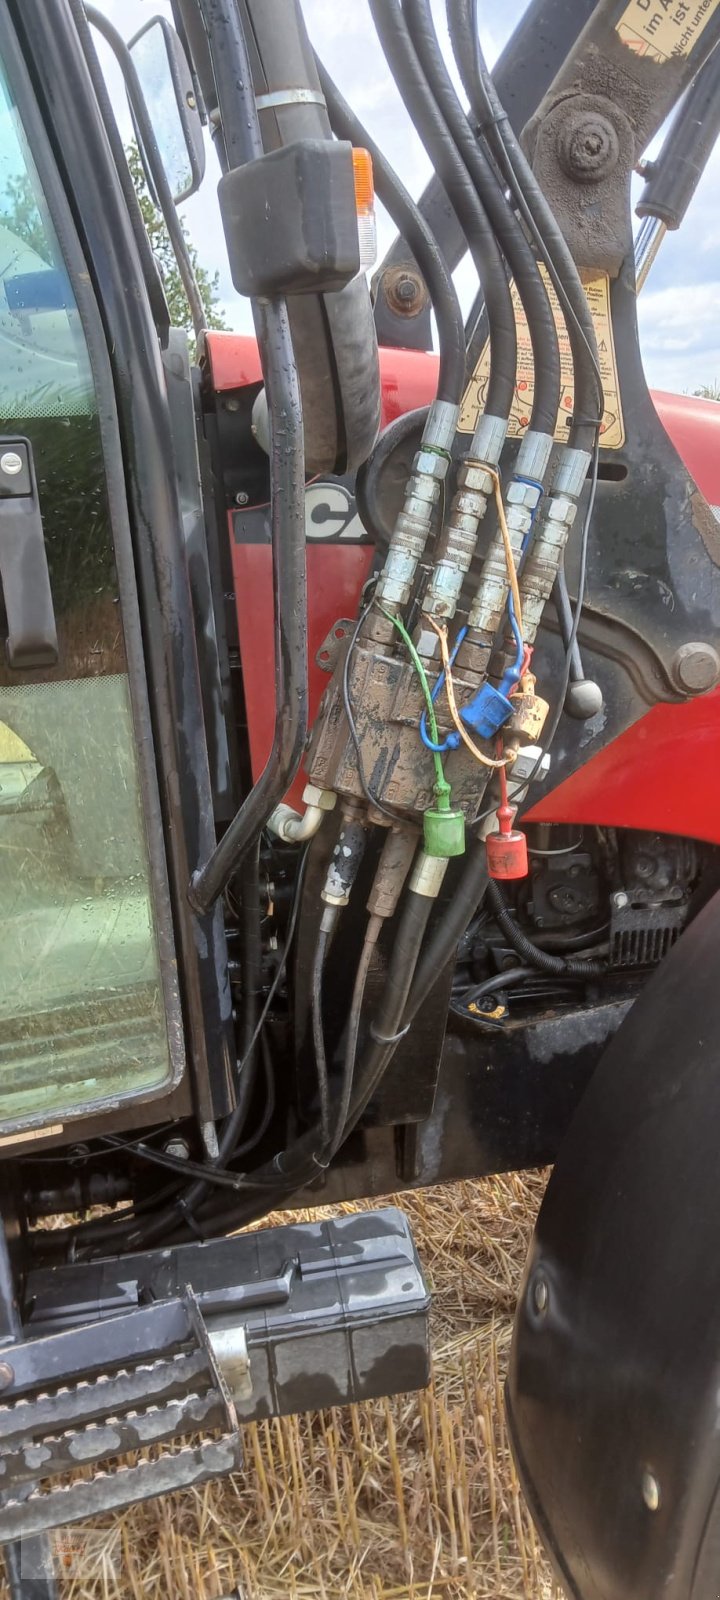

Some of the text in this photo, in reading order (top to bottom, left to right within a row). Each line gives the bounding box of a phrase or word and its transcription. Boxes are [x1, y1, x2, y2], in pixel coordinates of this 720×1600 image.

[643, 13, 663, 36] im
[669, 2, 690, 26] ist
[671, 0, 712, 57] Nicht unte
